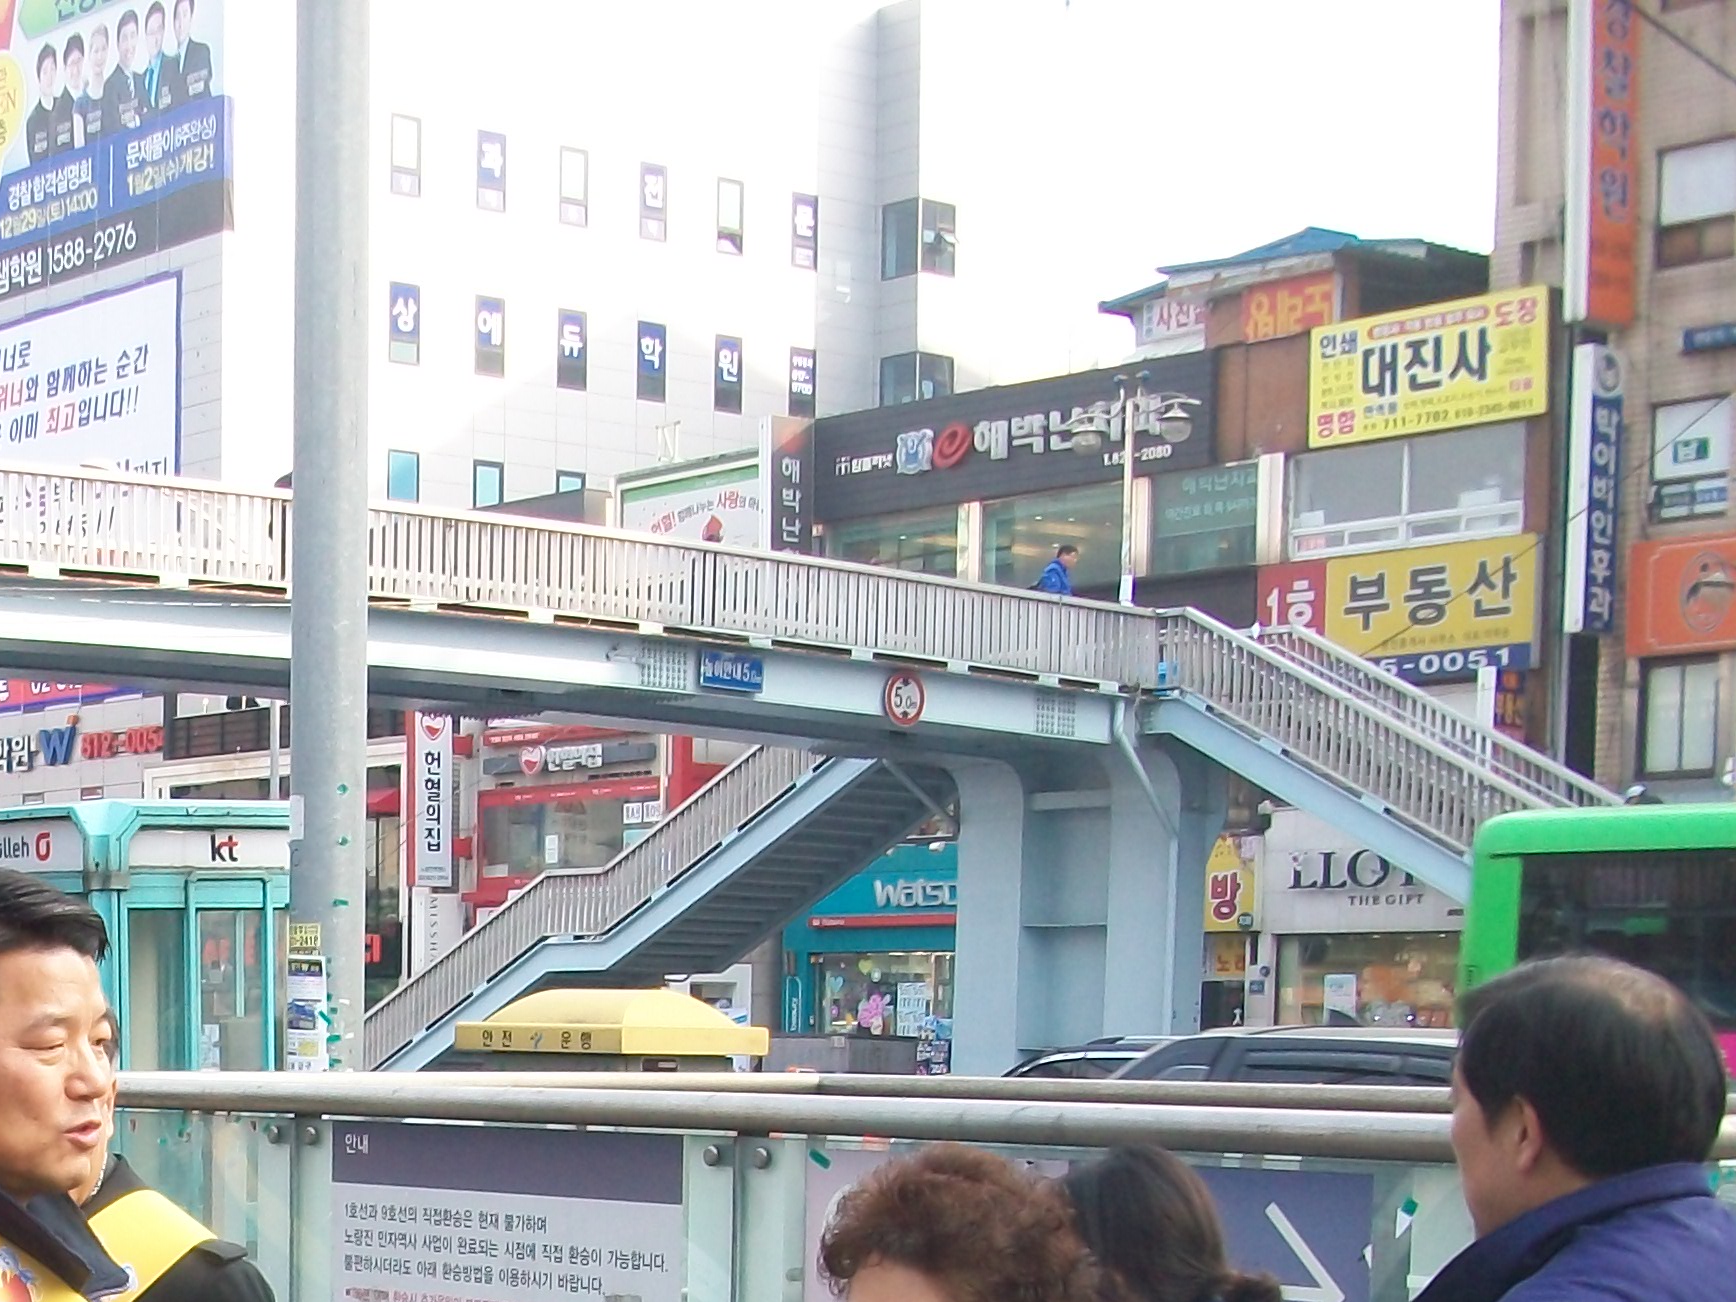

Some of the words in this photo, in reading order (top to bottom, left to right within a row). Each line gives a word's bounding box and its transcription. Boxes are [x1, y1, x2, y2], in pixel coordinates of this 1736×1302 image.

[47, 220, 137, 275] 1588-2976
[1495, 296, 1538, 328] 도장
[1320, 330, 1358, 359] 인쇄
[46, 355, 108, 397] 함께하는
[115, 343, 150, 379] 순간
[1362, 325, 1492, 398] 대진사
[9, 411, 39, 444] 이미
[1317, 410, 1356, 439] 명함
[1343, 555, 1518, 632] 부동산
[424, 750, 442, 853] 헌혈의집
[210, 834, 239, 864] kt
[1209, 871, 1241, 921] 방
[1347, 895, 1381, 907] THE
[1385, 893, 1425, 907] GIFT
[482, 1029, 513, 1049] 안전
[560, 1030, 593, 1051] 운행
[345, 1133, 370, 1155] 안내
[344, 1201, 378, 1223] 1호선과
[381, 1204, 418, 1224] 9호선의
[422, 1206, 473, 1230] 직접환승은
[478, 1210, 500, 1231] 현재
[504, 1212, 548, 1234] 불가하며
[343, 1228, 375, 1249] 노량진
[377, 1230, 418, 1251] 민자역사
[421, 1233, 454, 1254] 사업이
[457, 1236, 500, 1259] 완료되는
[504, 1240, 536, 1261] 시점에
[541, 1243, 564, 1264] 직접
[568, 1245, 603, 1267] 환승이
[607, 1249, 669, 1274] 가능합니다.
[343, 1253, 412, 1277] 불편하시더라도
[416, 1259, 438, 1279] 아래
[442, 1261, 494, 1286] 환승방법을
[498, 1267, 553, 1291] 이용하시기
[557, 1272, 607, 1296] 바랍니다.
